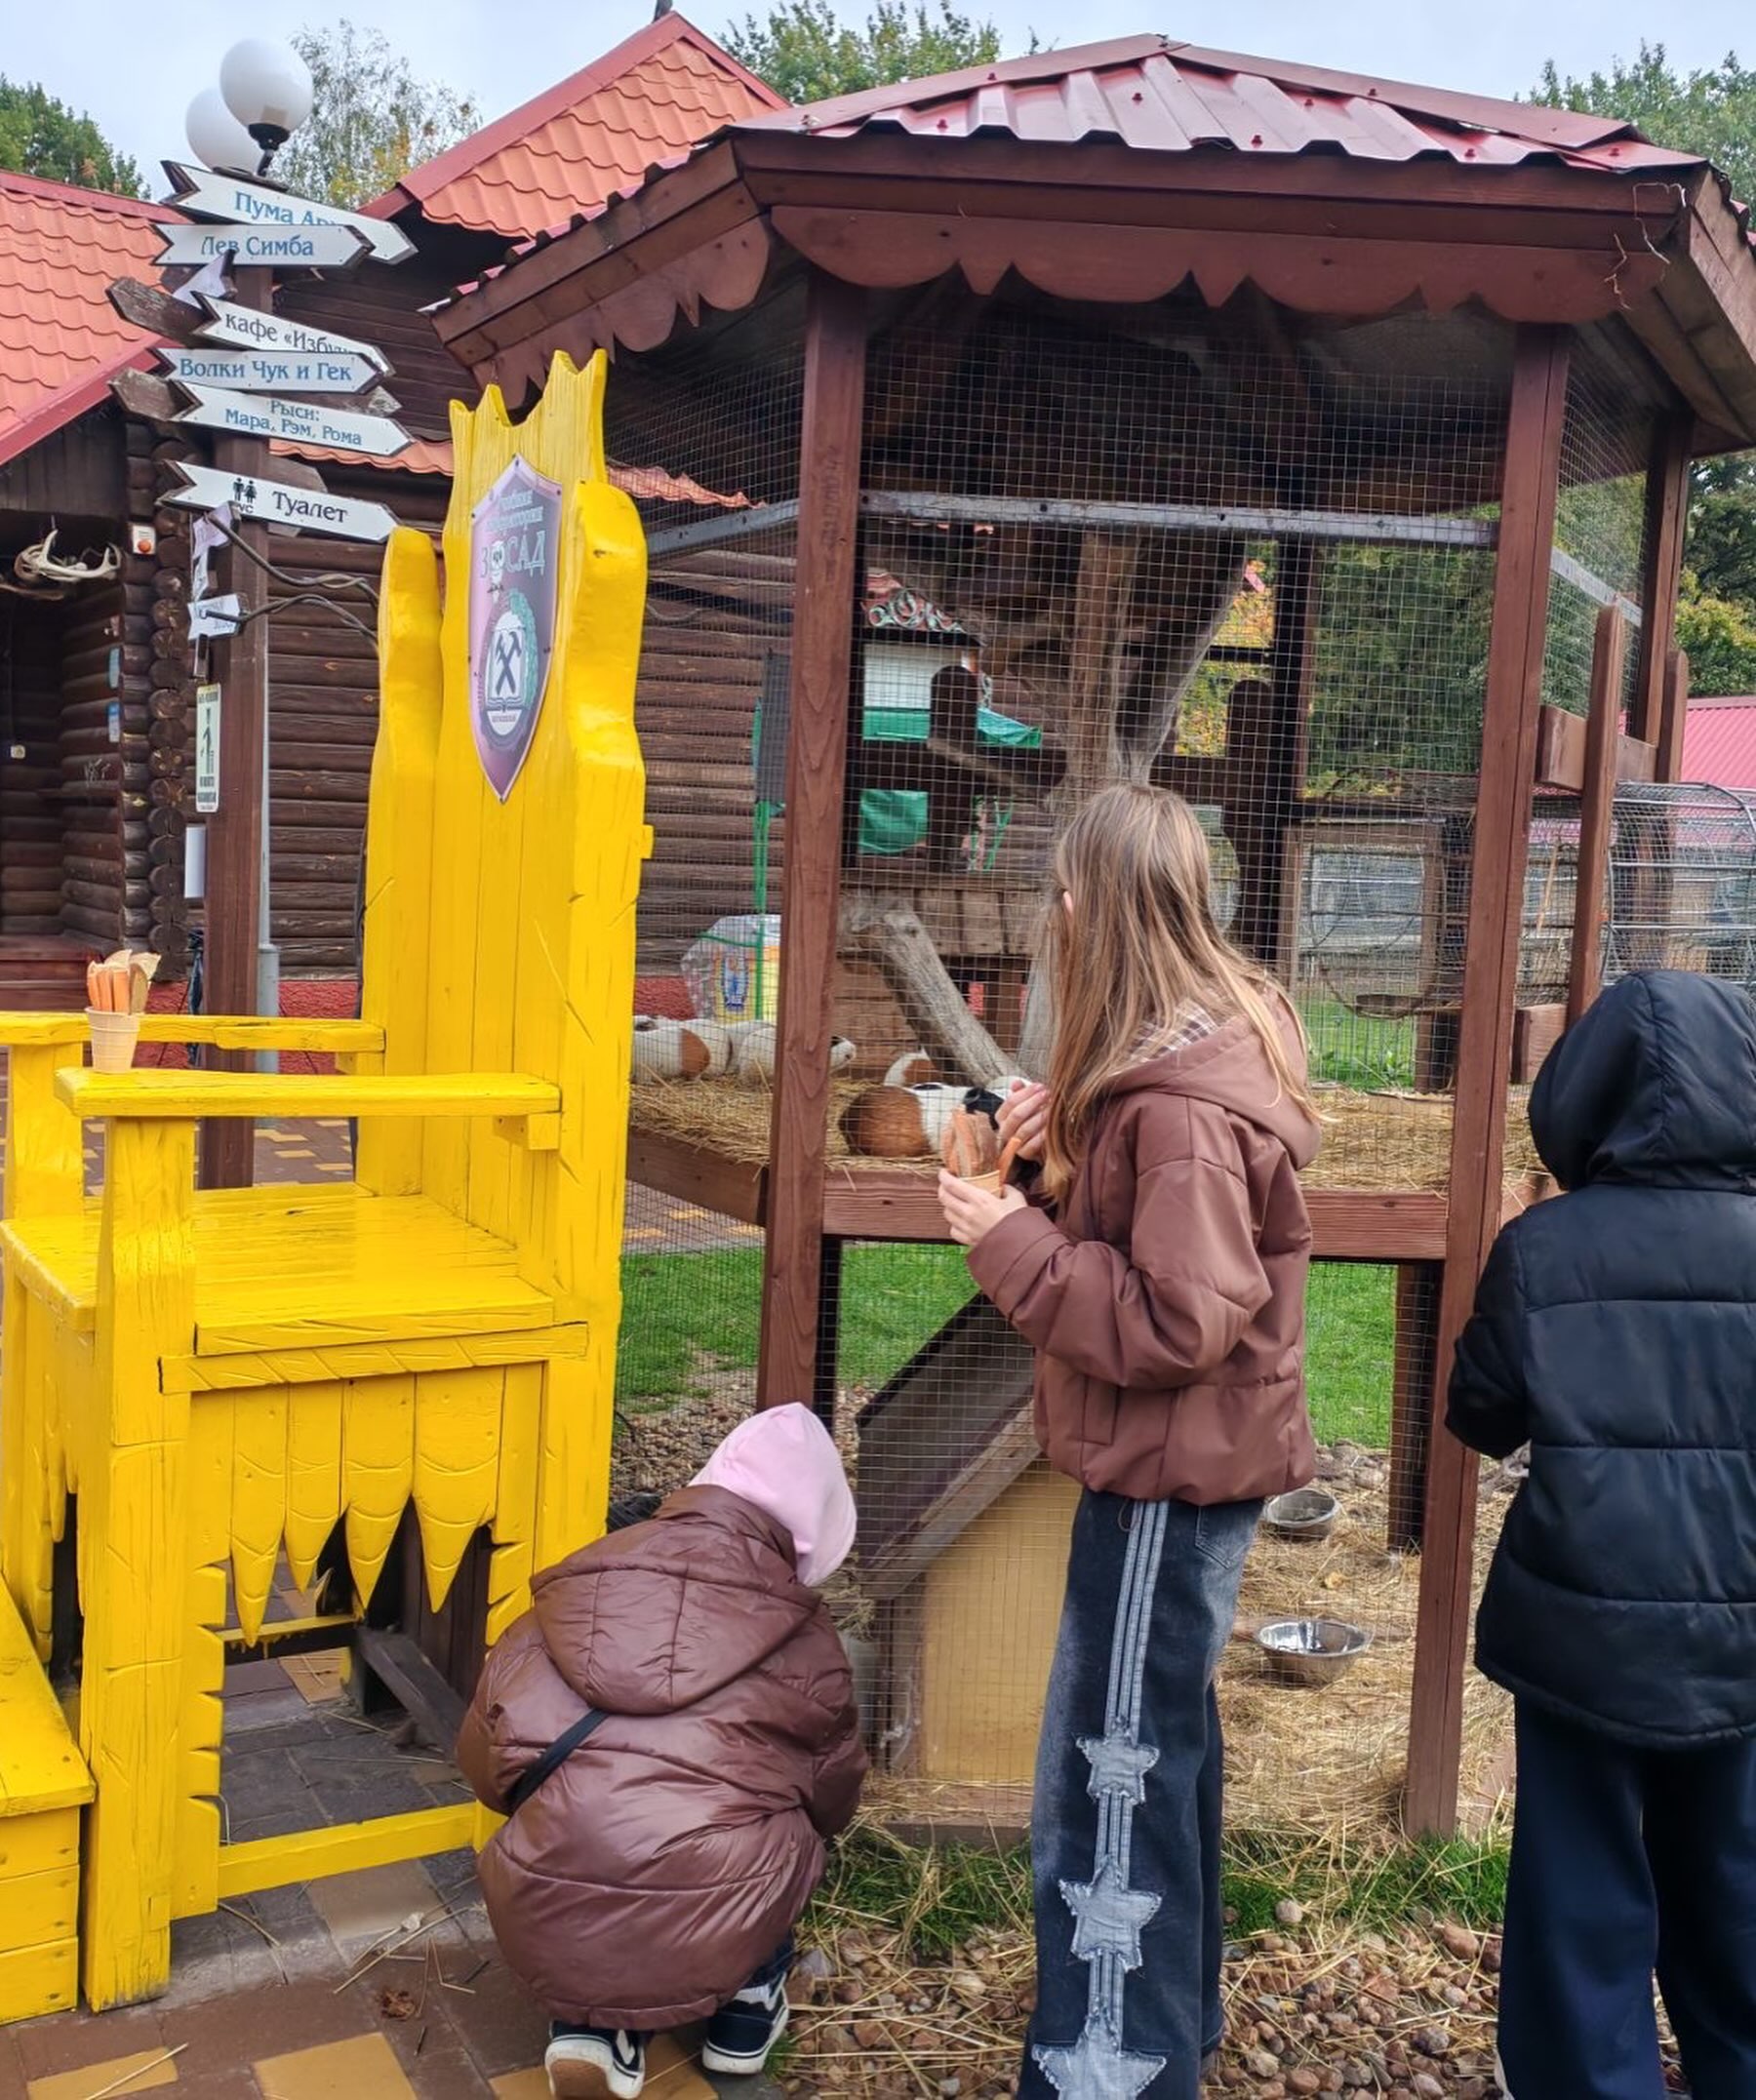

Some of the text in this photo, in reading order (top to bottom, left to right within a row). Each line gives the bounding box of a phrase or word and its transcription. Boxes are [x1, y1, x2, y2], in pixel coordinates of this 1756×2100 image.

[235, 191, 294, 223] Пума
[201, 234, 314, 256] Лев Симба
[180, 357, 352, 383] Волки Чук и Гек
[270, 400, 320, 421] Рыси:
[225, 408, 362, 446] Мара, Рэм, Рома
[272, 491, 347, 524] Туалет
